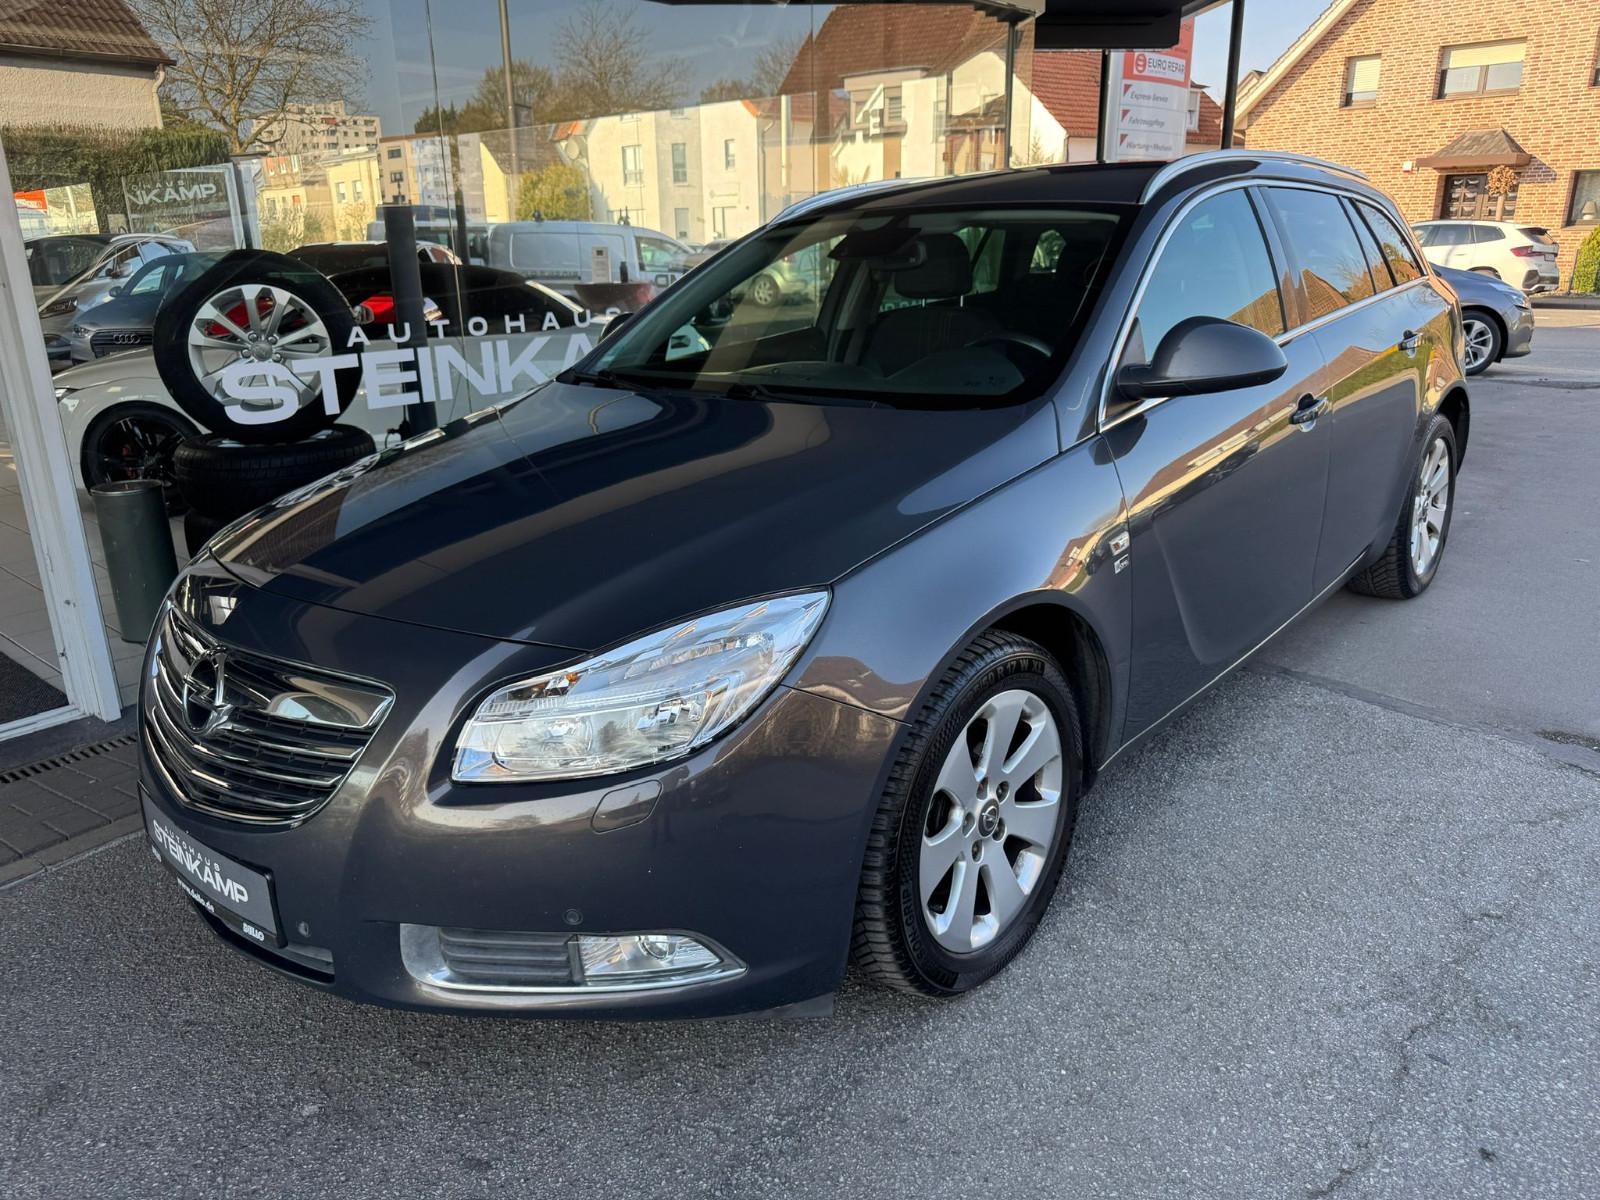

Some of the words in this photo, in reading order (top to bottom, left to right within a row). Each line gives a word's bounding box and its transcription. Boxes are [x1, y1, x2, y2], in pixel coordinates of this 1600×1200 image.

[1148, 57, 1167, 71] EURO
[154, 819, 249, 903] STEINKAMP
[165, 826, 220, 871] AUTOHAUS
